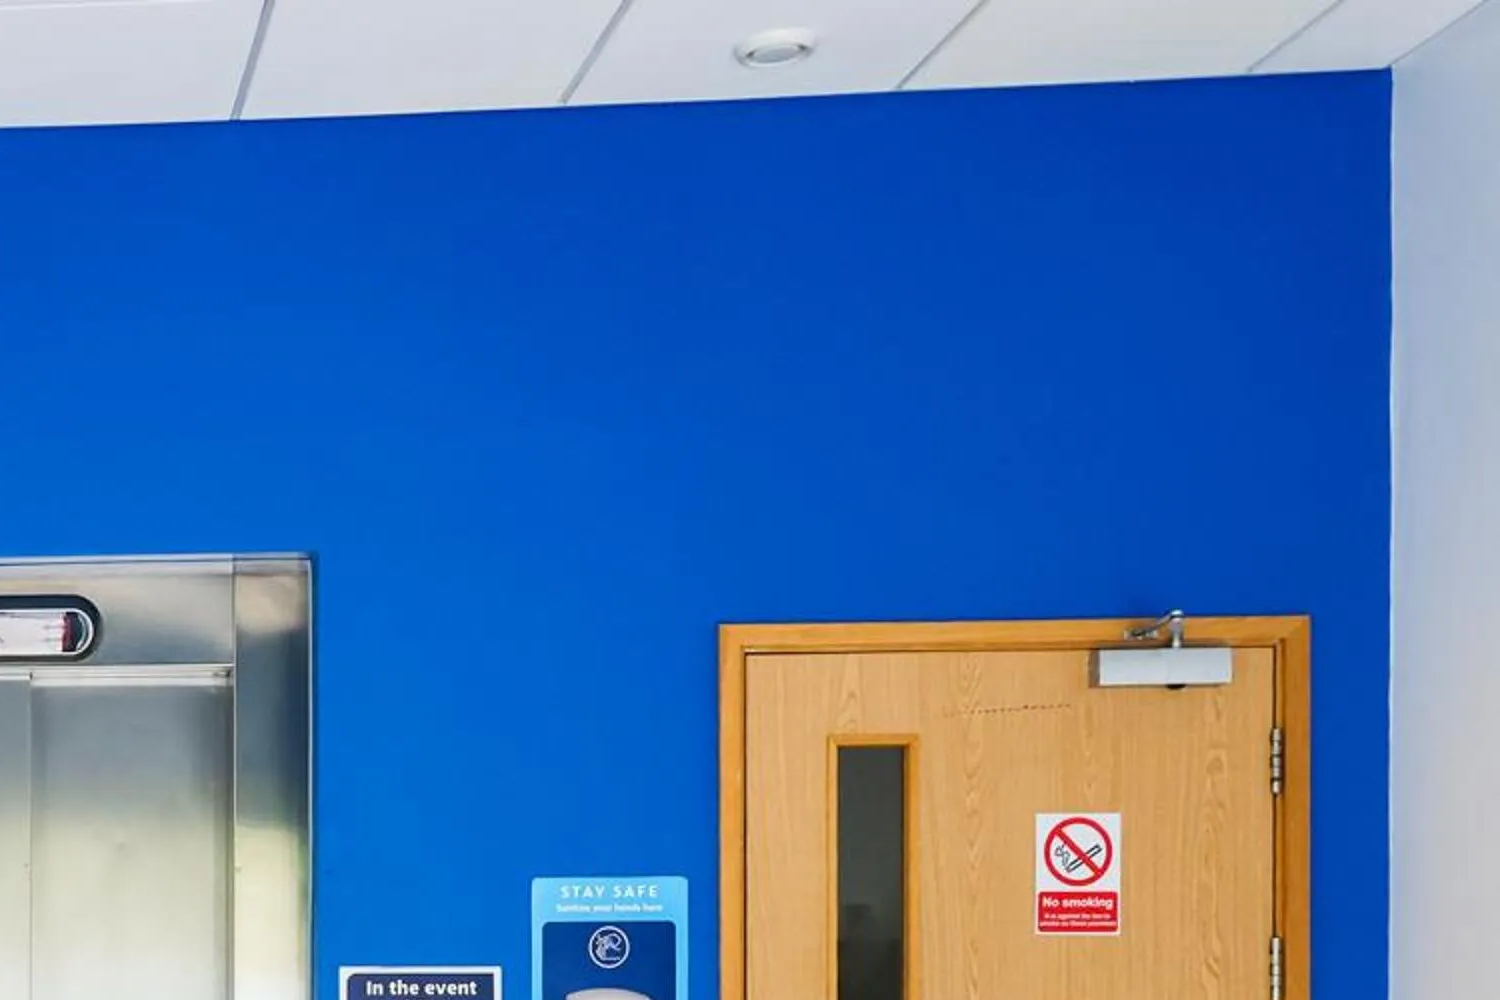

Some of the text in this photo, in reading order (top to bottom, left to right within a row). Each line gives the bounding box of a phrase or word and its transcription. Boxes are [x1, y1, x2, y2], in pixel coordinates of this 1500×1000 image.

[560, 884, 660, 899] STAY SAFE
[1043, 895, 1113, 911] No smoking
[366, 979, 477, 996] In the event
